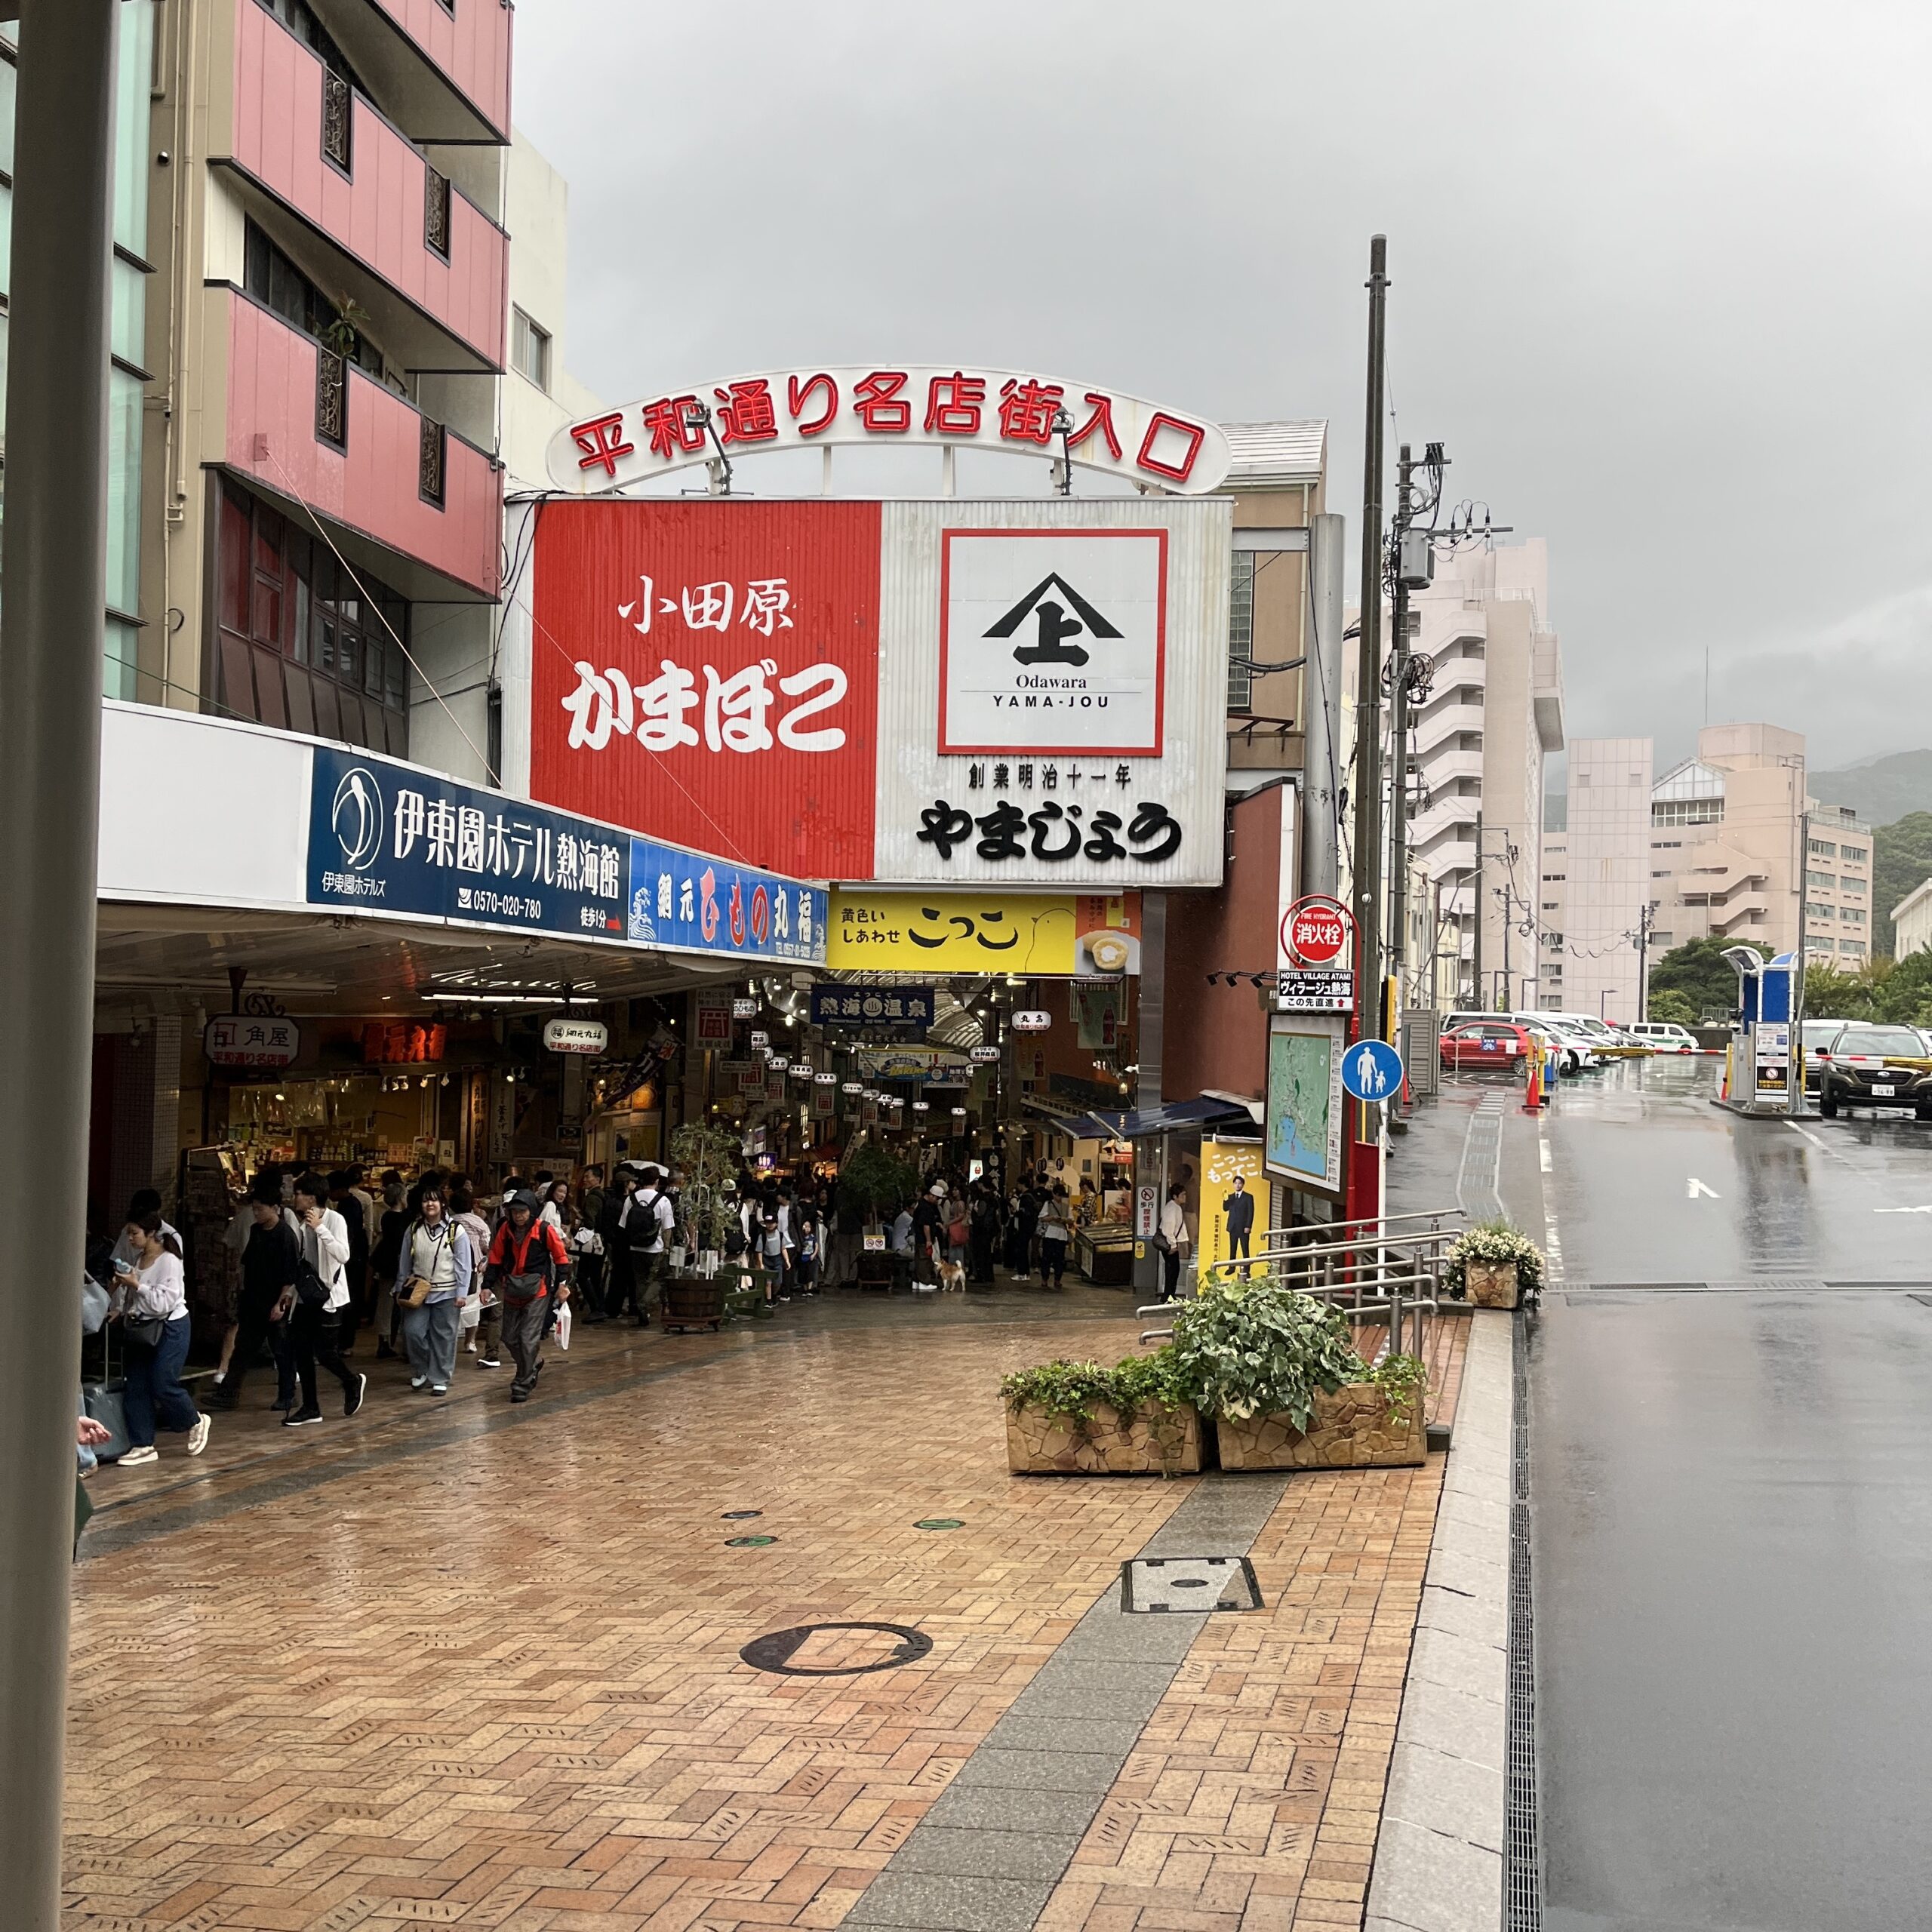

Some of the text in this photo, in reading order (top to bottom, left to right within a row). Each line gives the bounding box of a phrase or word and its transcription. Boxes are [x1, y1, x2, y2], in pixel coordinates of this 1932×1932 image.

[570, 370, 1205, 484] 平和通り名店街入口
[618, 576, 796, 635] 小田原
[1016, 674, 1087, 690] Odawara
[561, 659, 848, 752] かまぼこ
[994, 694, 1110, 709] YAMA-JOU
[969, 762, 1131, 790] 創業明治十一年
[915, 800, 1183, 863] やまじょう
[393, 789, 620, 900] 伊東園ホテル熱海館
[321, 870, 386, 897] 伊東園ホテルズ
[473, 890, 541, 919] 0570-020-780
[841, 908, 885, 924] 黄色い
[580, 906, 607, 929] 徒歩1分
[908, 907, 1019, 949] こっこ
[842, 928, 900, 943] しあわせ
[1296, 922, 1341, 946] 消火栓
[1303, 972, 1330, 980] VILLAGE
[1281, 981, 1351, 996] ヴィラージュ熱海
[1287, 998, 1334, 1007] この先直進
[243, 1026, 290, 1047] 角屋
[549, 1041, 601, 1053] 平和通り名店街
[213, 1051, 289, 1065] 平和通り名店街
